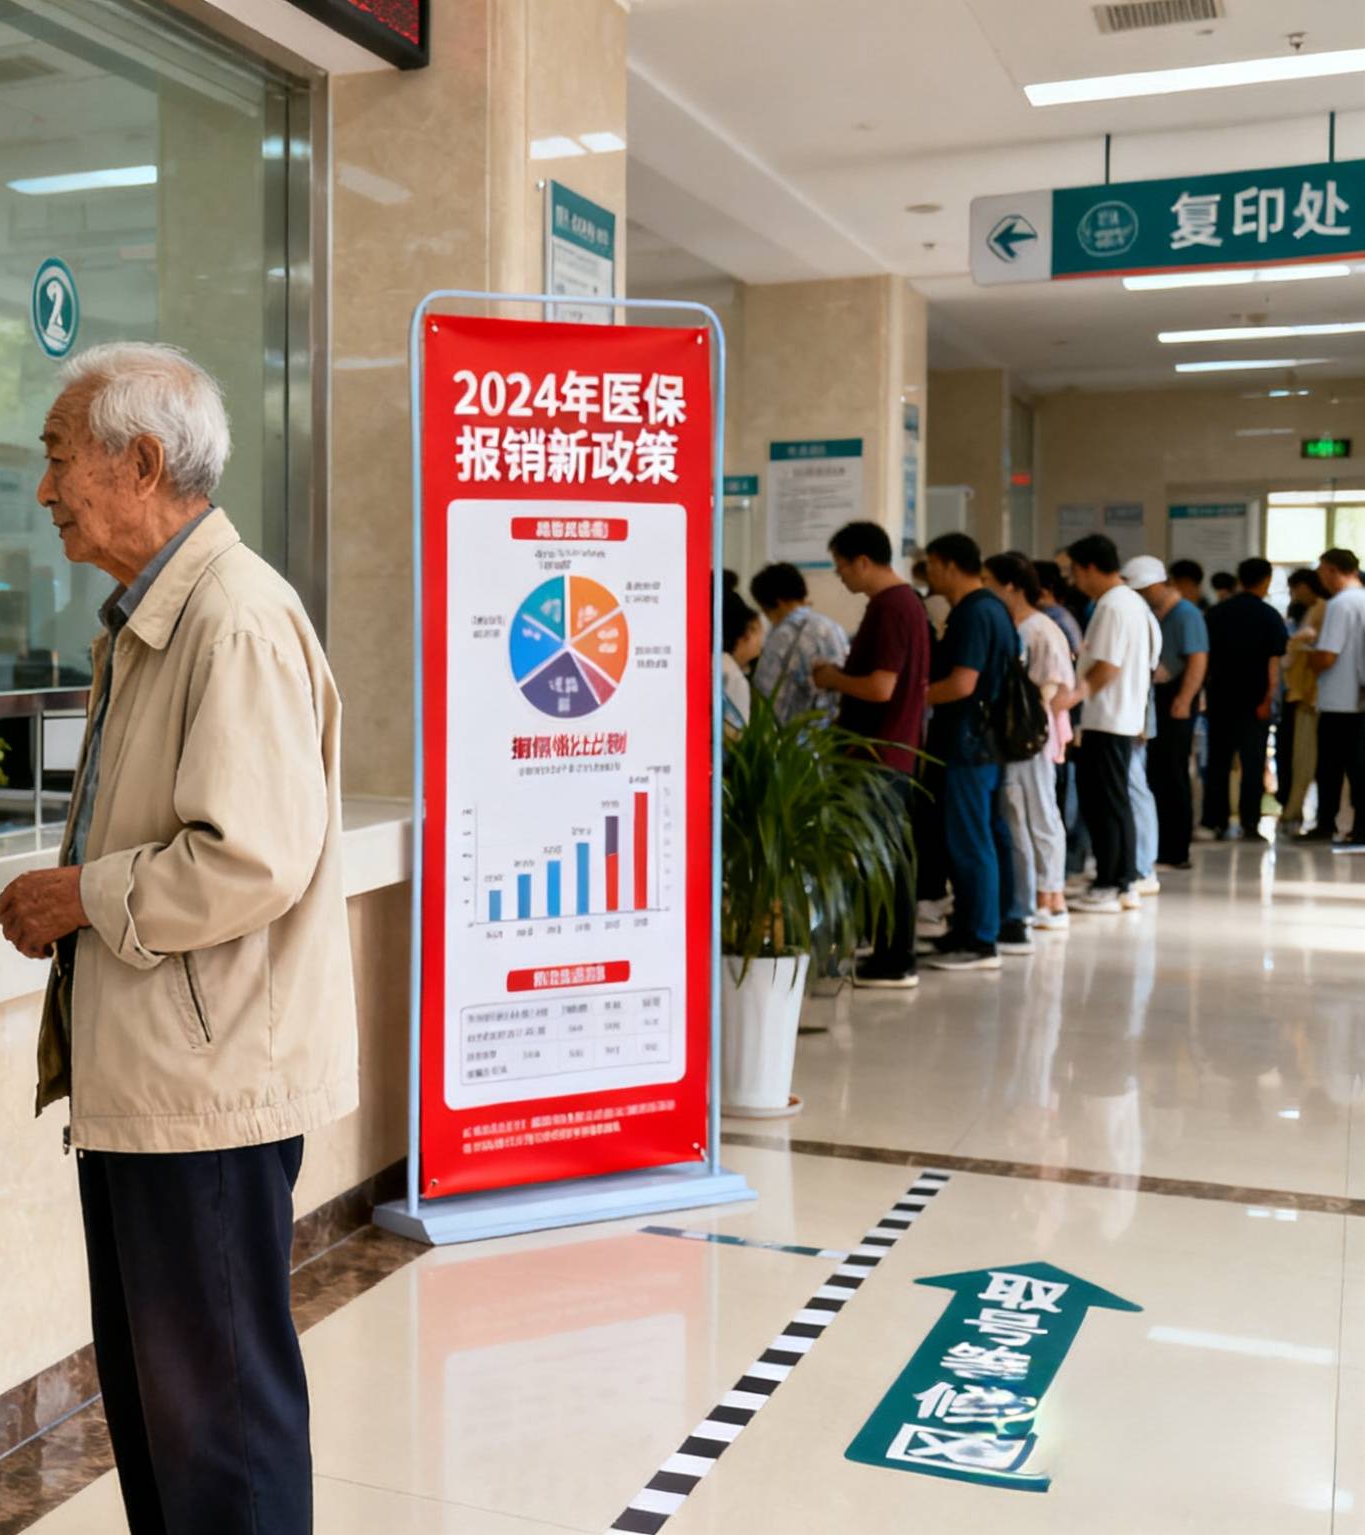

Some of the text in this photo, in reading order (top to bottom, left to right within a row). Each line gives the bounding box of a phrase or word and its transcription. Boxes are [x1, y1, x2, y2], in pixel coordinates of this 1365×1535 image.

[1170, 180, 1351, 250] 复印处
[453, 370, 687, 427] 2024年医保
[455, 424, 679, 485] 报销新政策
